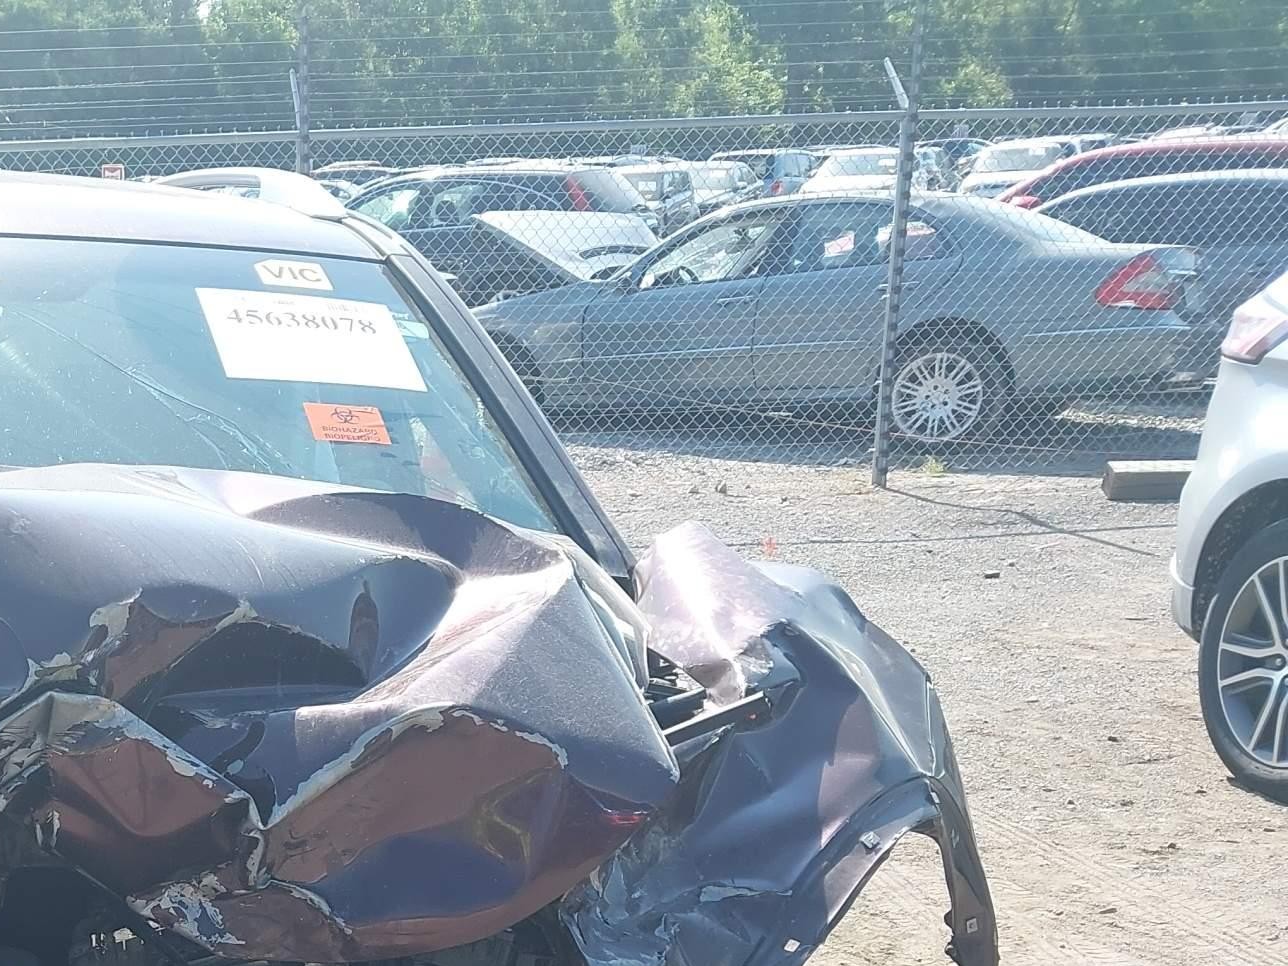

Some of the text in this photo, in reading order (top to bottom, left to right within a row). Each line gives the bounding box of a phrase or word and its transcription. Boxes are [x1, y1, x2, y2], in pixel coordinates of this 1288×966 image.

[263, 266, 323, 282] VIC
[227, 309, 377, 334] 45638078
[321, 425, 378, 435] BIOHAZARD
